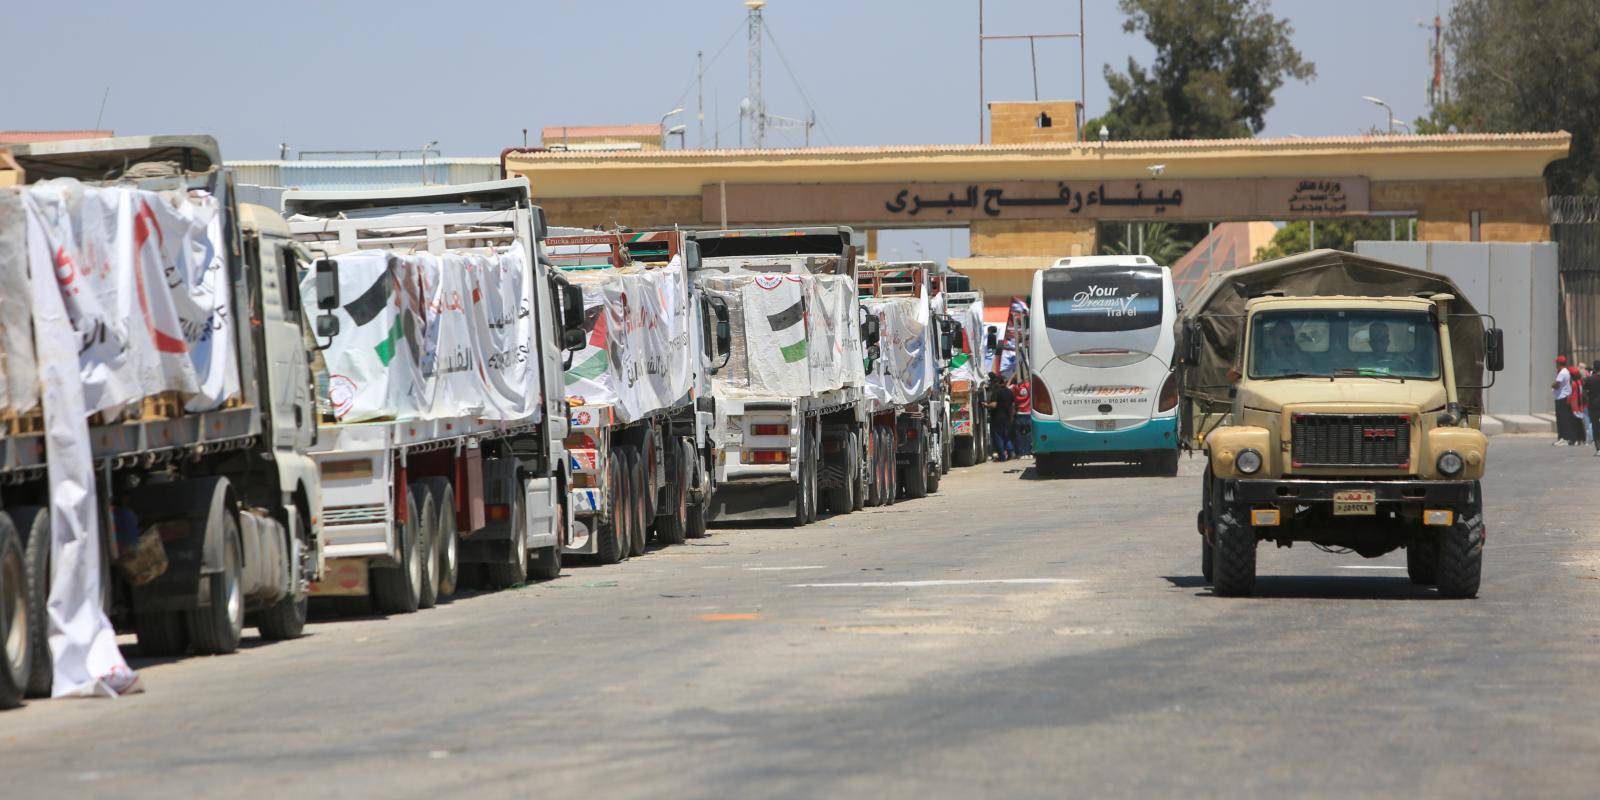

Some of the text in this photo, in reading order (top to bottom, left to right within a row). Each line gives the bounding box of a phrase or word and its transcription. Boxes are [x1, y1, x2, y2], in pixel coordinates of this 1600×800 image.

[983, 182, 1083, 216] رفح
[1086, 183, 1183, 213] ميناء
[1072, 291, 1120, 308] Dreams
[1088, 284, 1119, 297] Your
